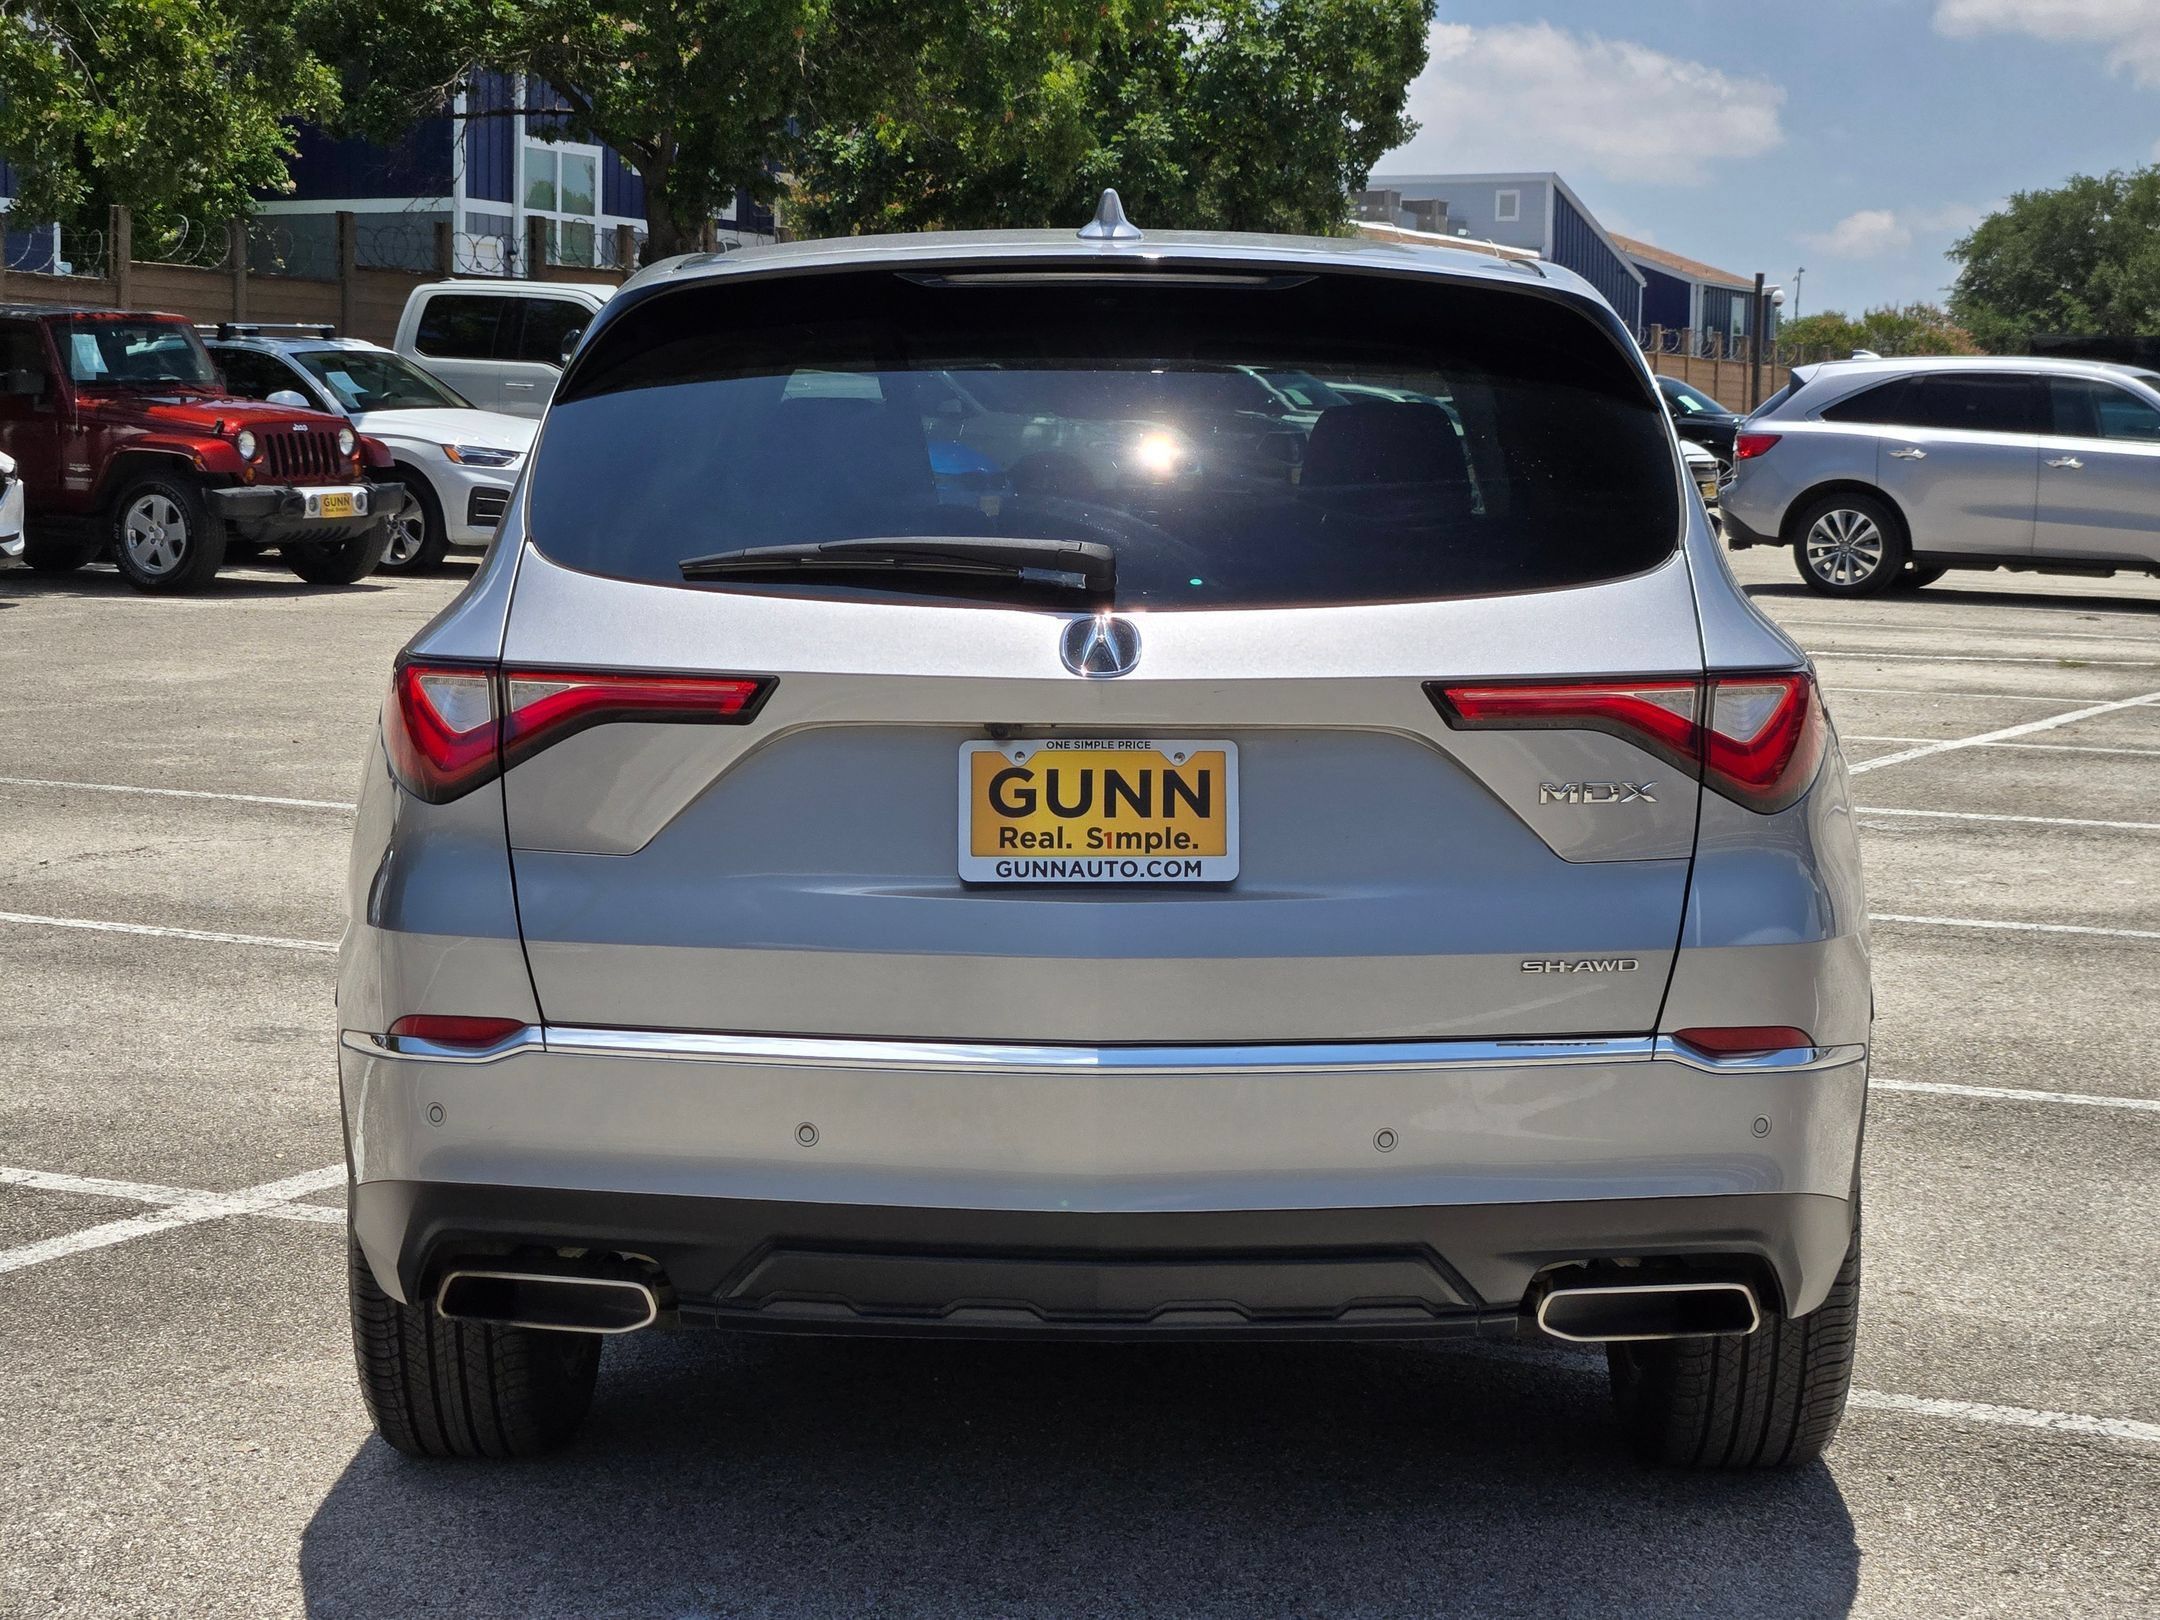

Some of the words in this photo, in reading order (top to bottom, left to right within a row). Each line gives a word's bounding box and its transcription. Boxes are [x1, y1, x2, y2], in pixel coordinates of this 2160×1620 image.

[323, 496, 350, 507] GUNN
[1046, 740, 1071, 750] ONE
[1074, 740, 1114, 750] SIMPLE
[1118, 740, 1151, 750] PRICE
[988, 767, 1211, 819] GUNN
[1539, 782, 1658, 804] MDX
[999, 826, 1072, 850] Real.
[995, 860, 1202, 879] GUNNAUTO.COM
[1521, 958, 1640, 974] SH-AWD
